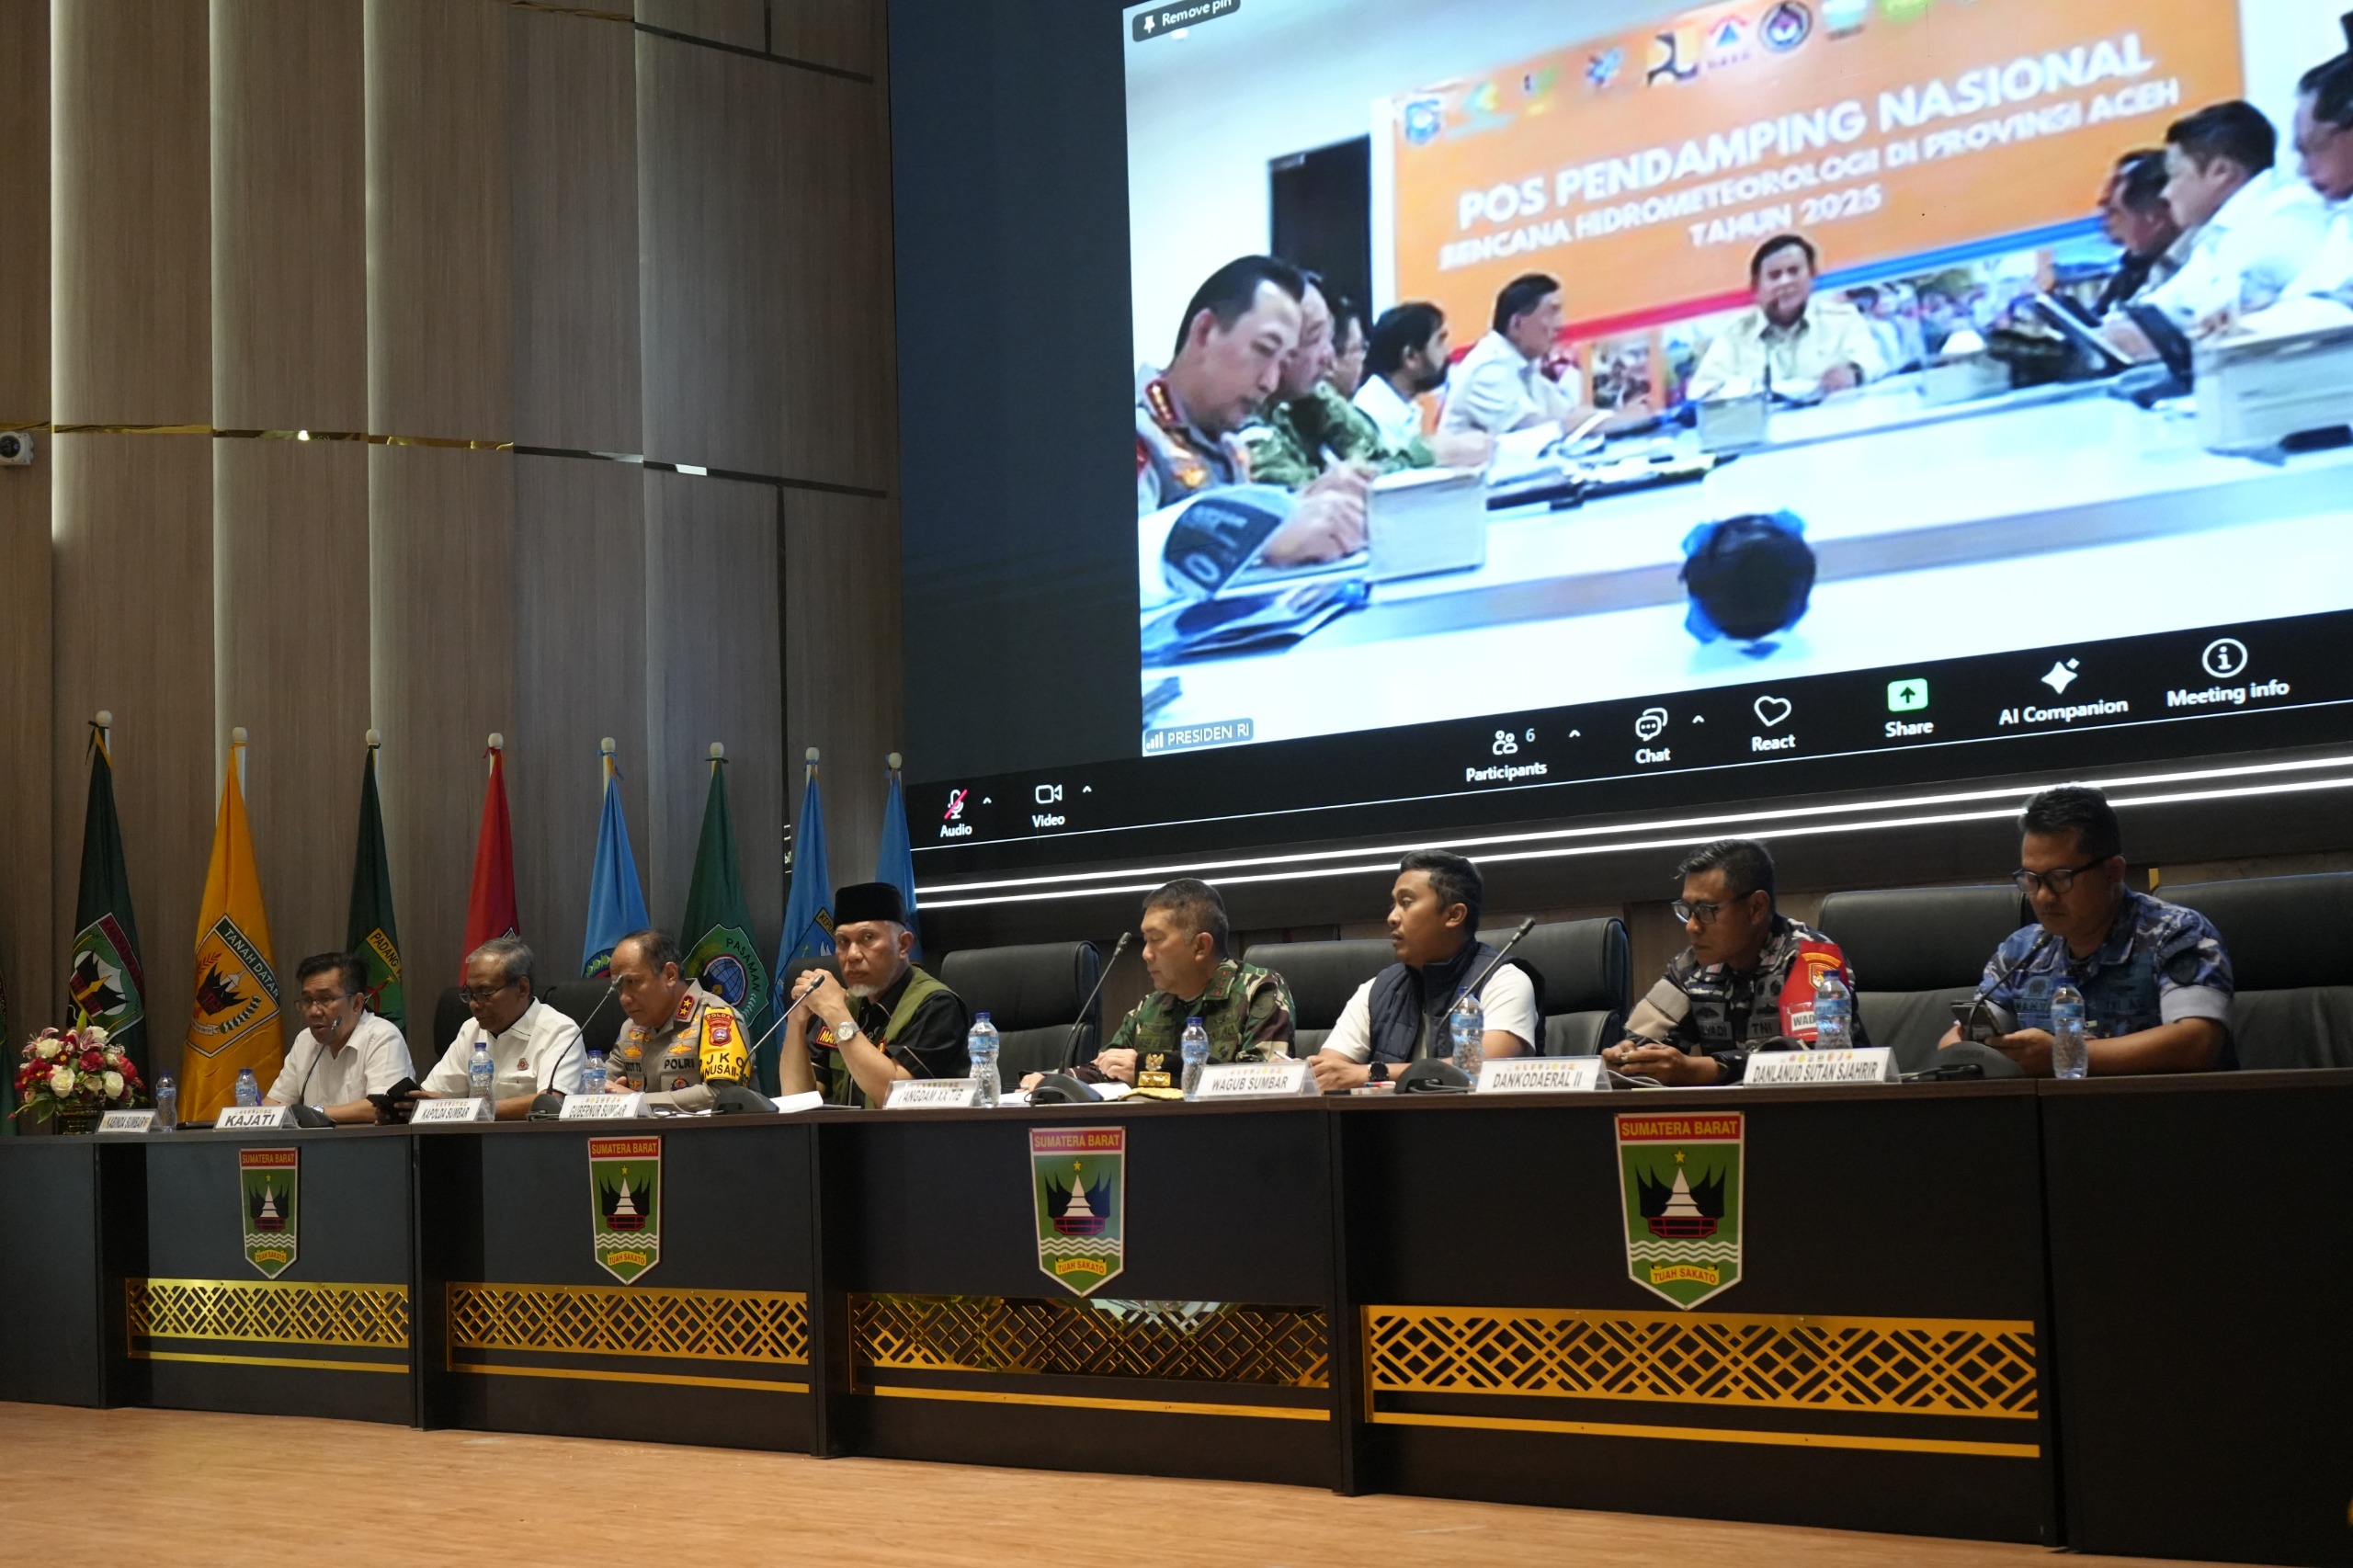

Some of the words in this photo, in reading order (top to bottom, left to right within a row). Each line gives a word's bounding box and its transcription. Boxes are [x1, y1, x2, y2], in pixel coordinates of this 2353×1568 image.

[1162, 4, 1211, 27] Remove
[1212, 0, 1232, 14] pin
[1886, 141, 1918, 167] DI
[1924, 101, 2082, 159] PROVINSI
[2086, 77, 2179, 125] ACEH
[1459, 176, 1548, 230] POS
[1556, 102, 1867, 207] PENDAMPING
[1878, 33, 2155, 131] NASIONAL
[1688, 202, 1793, 247] TAHUN
[1801, 183, 1882, 224] 2025
[2166, 684, 2245, 707] Meeting
[2250, 678, 2290, 698] info
[1998, 706, 2019, 725] AI
[2023, 698, 2129, 723] Companion
[1167, 724, 1233, 746] PRESIDEN
[1236, 722, 1250, 737] RI
[1525, 728, 1536, 742] 6
[1884, 719, 1934, 738] Share
[1752, 734, 1796, 752] React
[1635, 747, 1671, 764] Chat
[1466, 762, 1548, 782] Participants
[1032, 813, 1065, 828] Video
[940, 824, 972, 838] Audio
[223, 927, 256, 965] TANAH
[369, 931, 399, 967] PADANG
[726, 937, 761, 993] PASAMAN
[1793, 1012, 1815, 1027] WAD
[1751, 1022, 1773, 1035] TNI
[664, 1058, 695, 1070] POLRI
[1753, 1064, 1803, 1083] DANLANUD
[1803, 1063, 1837, 1082] SUTAN
[1837, 1062, 1879, 1081] SJAHRIR
[1211, 1077, 1246, 1091] WAGUB
[1247, 1075, 1289, 1090] SUMBAR
[1493, 1071, 1571, 1088] DANKODAERAL
[1573, 1071, 1583, 1086] II
[224, 1113, 276, 1127] KAJATI
[1621, 1121, 1691, 1137] SUMATERA
[1694, 1120, 1737, 1135] BARAT
[592, 1142, 631, 1154] SUMATERA
[633, 1142, 657, 1153] BARAT
[1034, 1135, 1086, 1148] SUMATERA
[1087, 1134, 1120, 1147] BARAT
[242, 1154, 274, 1164] SUMATERA
[275, 1153, 295, 1163] BARAT
[609, 1254, 623, 1265] TUAH
[624, 1253, 645, 1265] SAKATO
[1057, 1261, 1076, 1273] TUAH
[1077, 1260, 1105, 1274] SAKATO
[1654, 1268, 1677, 1283] TUAH
[1679, 1267, 1717, 1283] SAKATO
